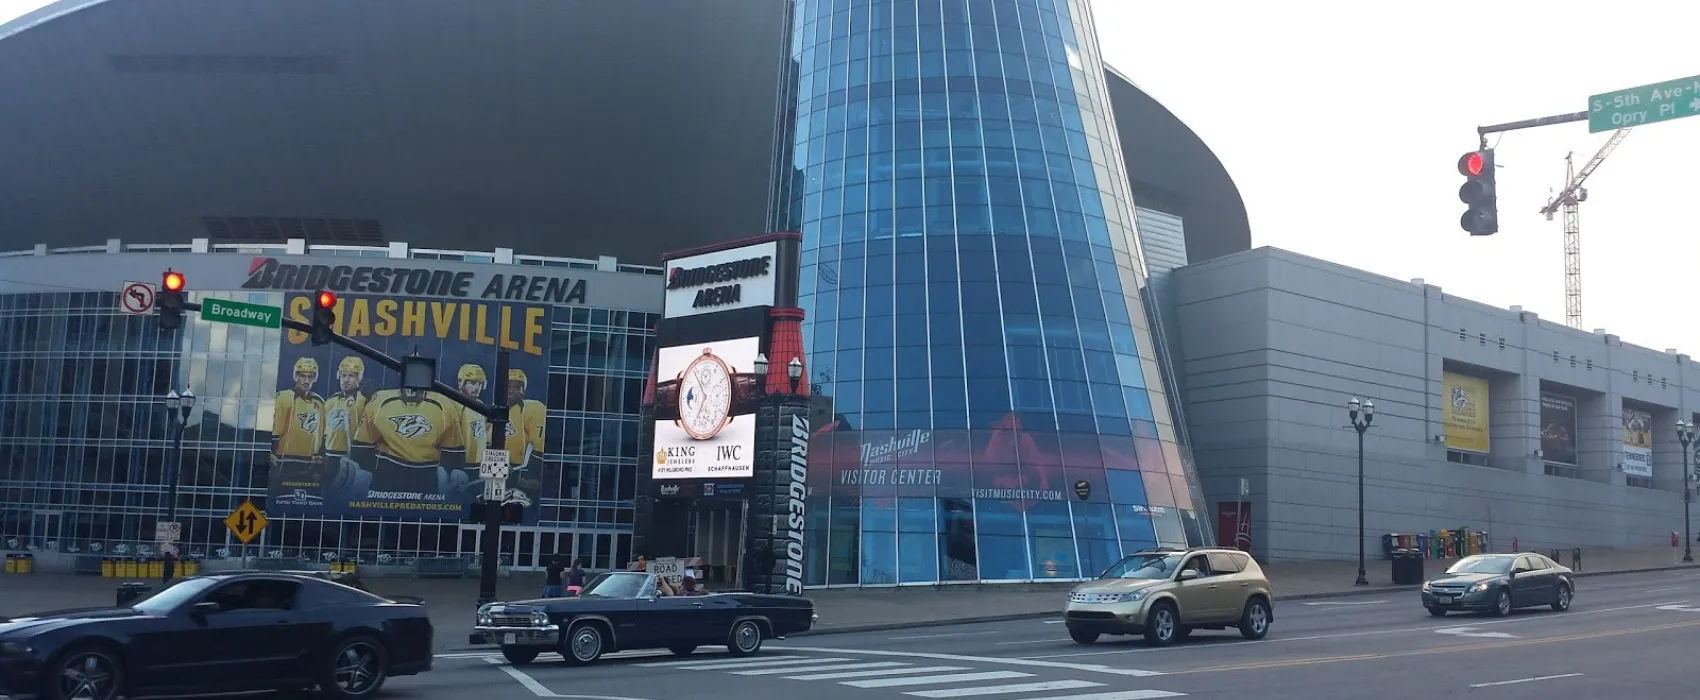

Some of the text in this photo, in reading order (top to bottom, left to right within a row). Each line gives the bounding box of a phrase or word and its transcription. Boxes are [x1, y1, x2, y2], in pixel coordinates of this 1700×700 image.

[1592, 92, 1640, 113] S-5th
[1611, 101, 1676, 127] Opry Pl
[241, 257, 587, 304] BRIDGESTONE ARENA
[667, 255, 771, 308] BRIDGESTONE ARENA
[211, 303, 272, 324] Broadway
[667, 446, 696, 457] KING
[717, 445, 742, 461] IWC
[481, 463, 493, 474] OK
[841, 470, 941, 485] VISITOR CENTER
[367, 489, 446, 501] BRIDGESTONE ARENA
[348, 501, 462, 511] NASHVILLEPREDATORS.COM
[785, 413, 810, 595] BRIDGESTONE
[653, 564, 678, 574] ROAD
